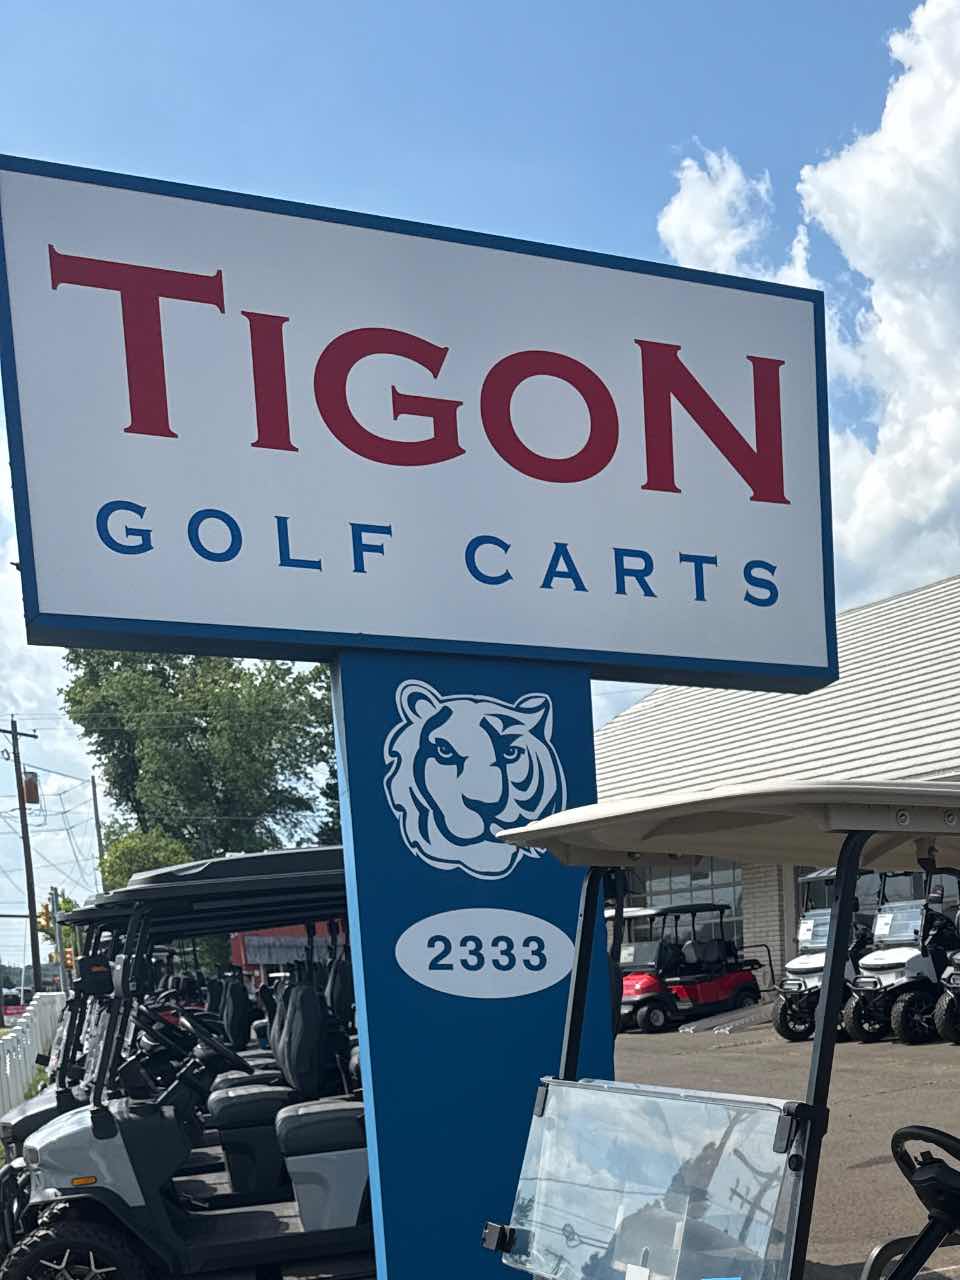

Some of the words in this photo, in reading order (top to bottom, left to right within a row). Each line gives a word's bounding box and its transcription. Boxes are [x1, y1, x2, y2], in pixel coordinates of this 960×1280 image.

[48, 245, 790, 505] TIGON
[95, 499, 394, 575] GOLF
[464, 533, 781, 608] CARTS
[427, 934, 547, 972] 2333
